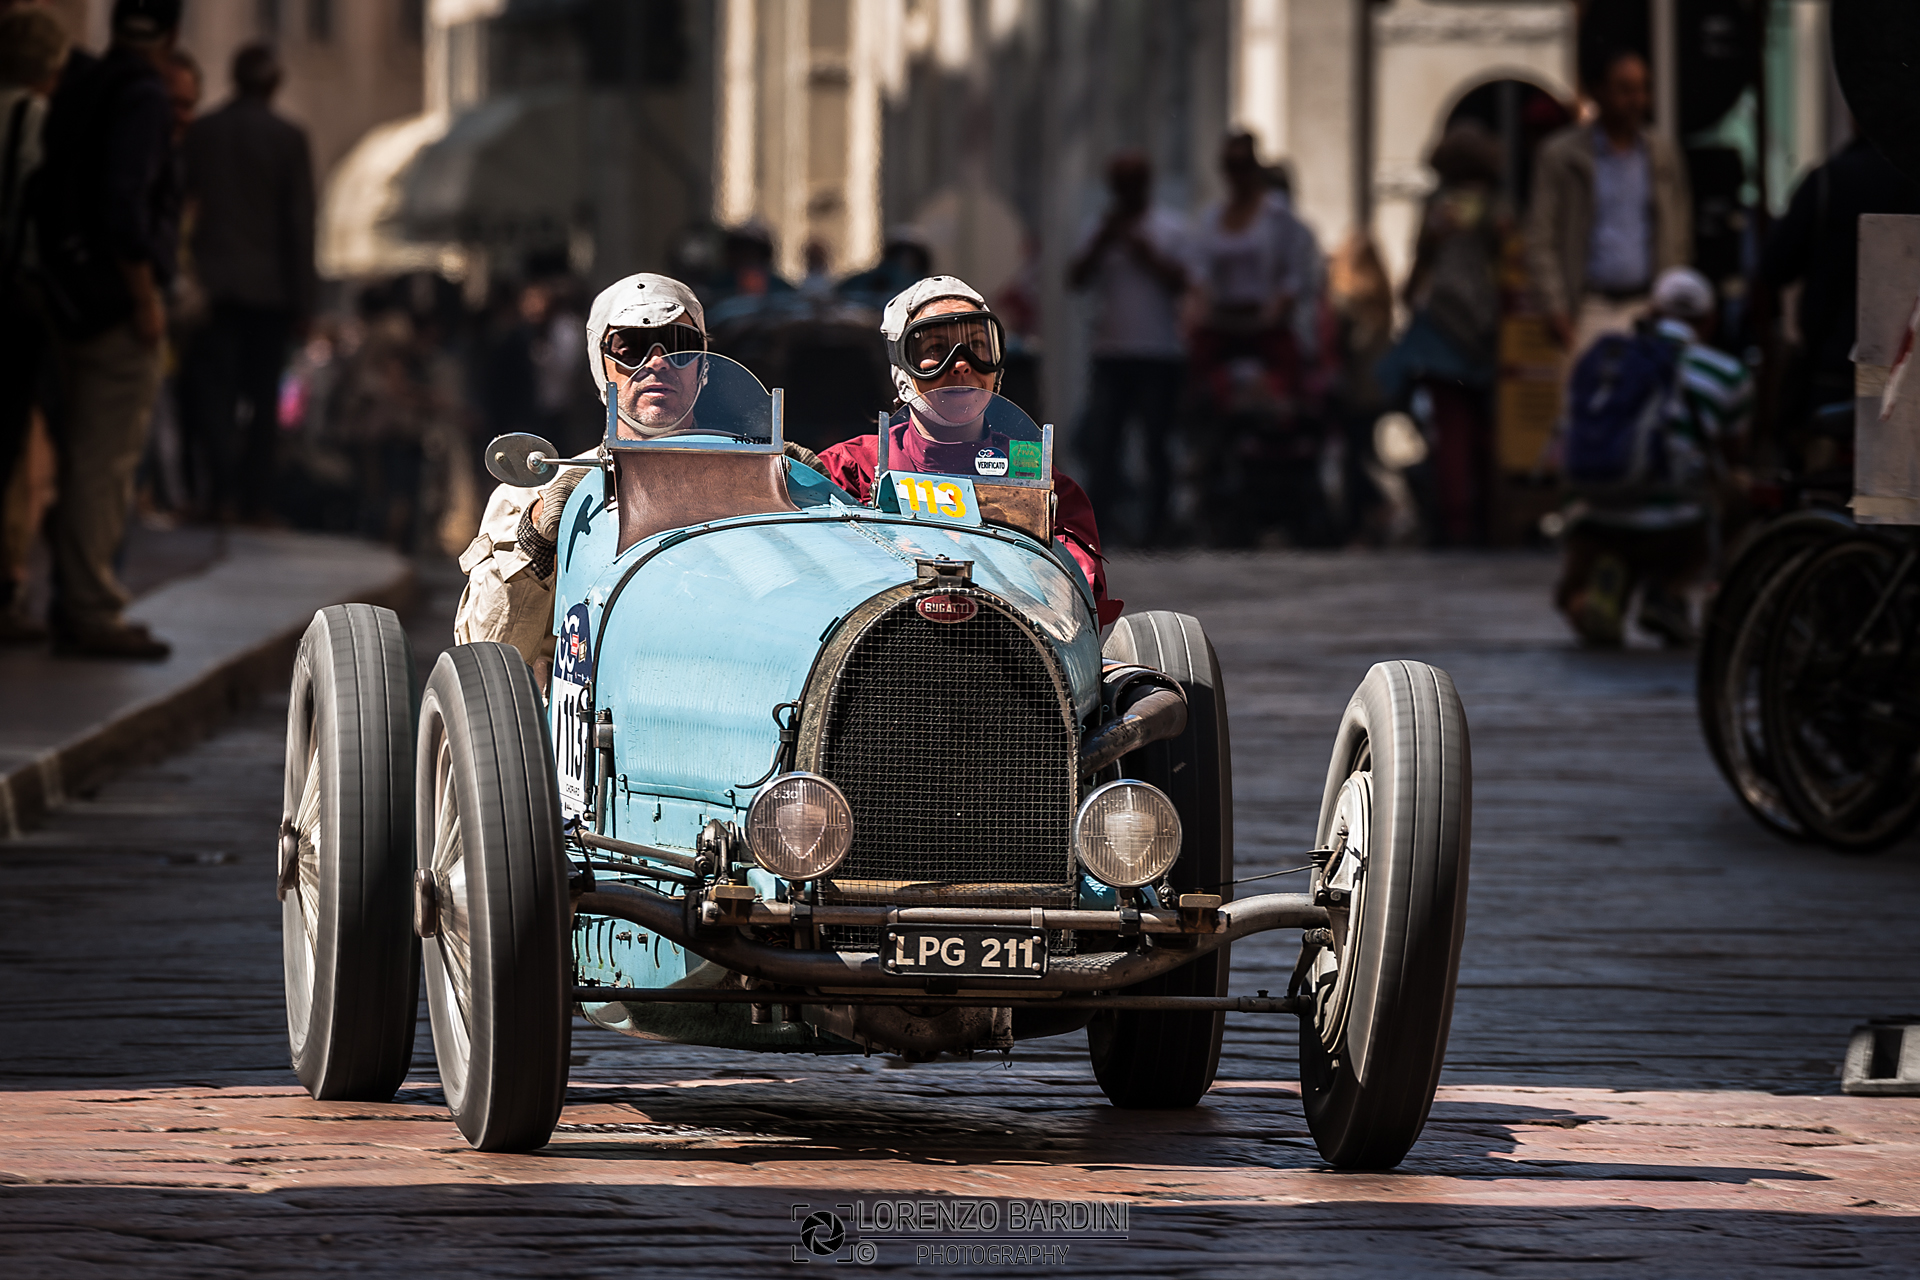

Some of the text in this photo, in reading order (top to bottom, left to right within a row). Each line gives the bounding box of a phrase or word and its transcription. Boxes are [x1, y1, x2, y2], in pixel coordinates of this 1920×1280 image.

[977, 461, 1006, 470] VERIFICATO
[899, 477, 967, 518] 113
[925, 602, 970, 613] BUGATTI
[895, 935, 1034, 968] LPG 211
